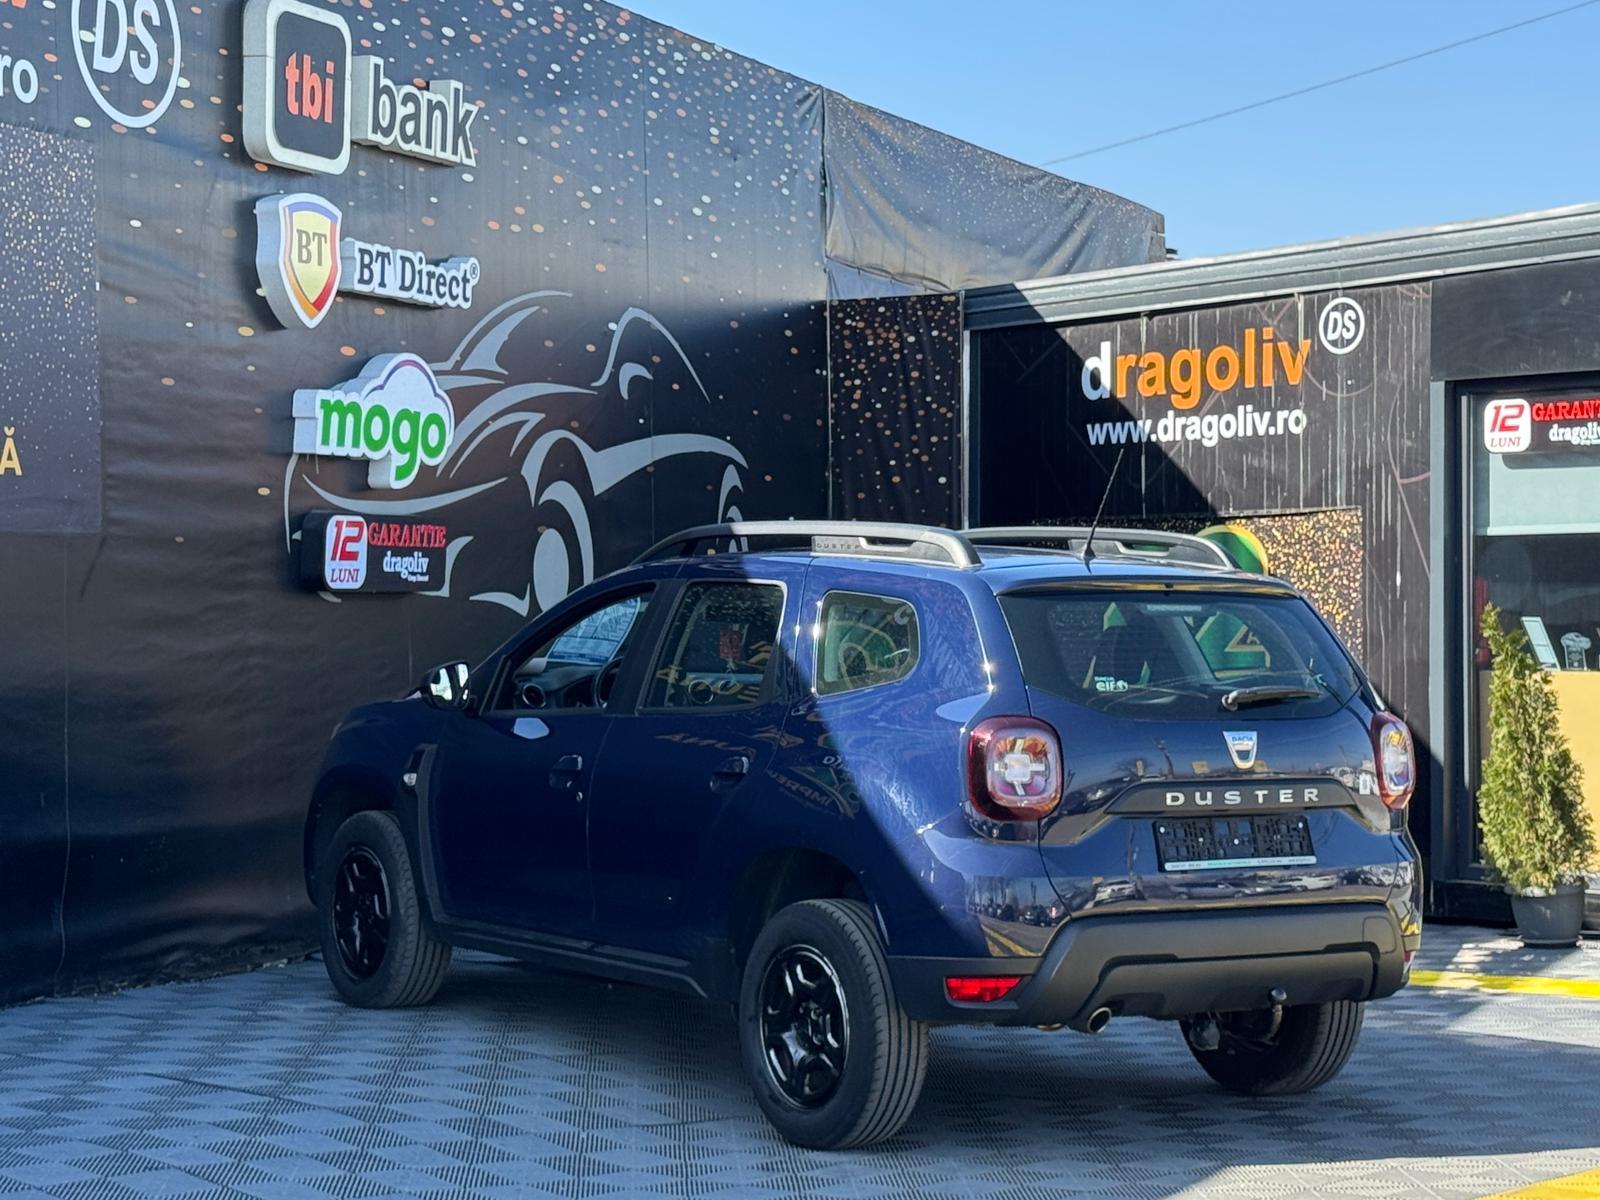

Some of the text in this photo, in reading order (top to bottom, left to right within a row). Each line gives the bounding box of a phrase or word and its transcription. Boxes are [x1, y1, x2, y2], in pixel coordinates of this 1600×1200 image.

[93, 0, 160, 85] DS
[285, 51, 473, 161] tbi bank
[296, 229, 327, 266] BT
[357, 247, 392, 288] BT
[1326, 311, 1357, 342] DS
[1081, 326, 1312, 410] dragoliv
[1086, 404, 1307, 448] www.dragoliv.ro
[1490, 405, 1524, 432] 12
[320, 398, 447, 481] mogo
[1490, 437, 1522, 448] LUNI
[330, 520, 365, 562] 12
[368, 522, 446, 549] GARANTIE
[330, 568, 360, 583] LUNI
[383, 550, 429, 579] dragoliv
[1165, 788, 1320, 806] DUSTER
